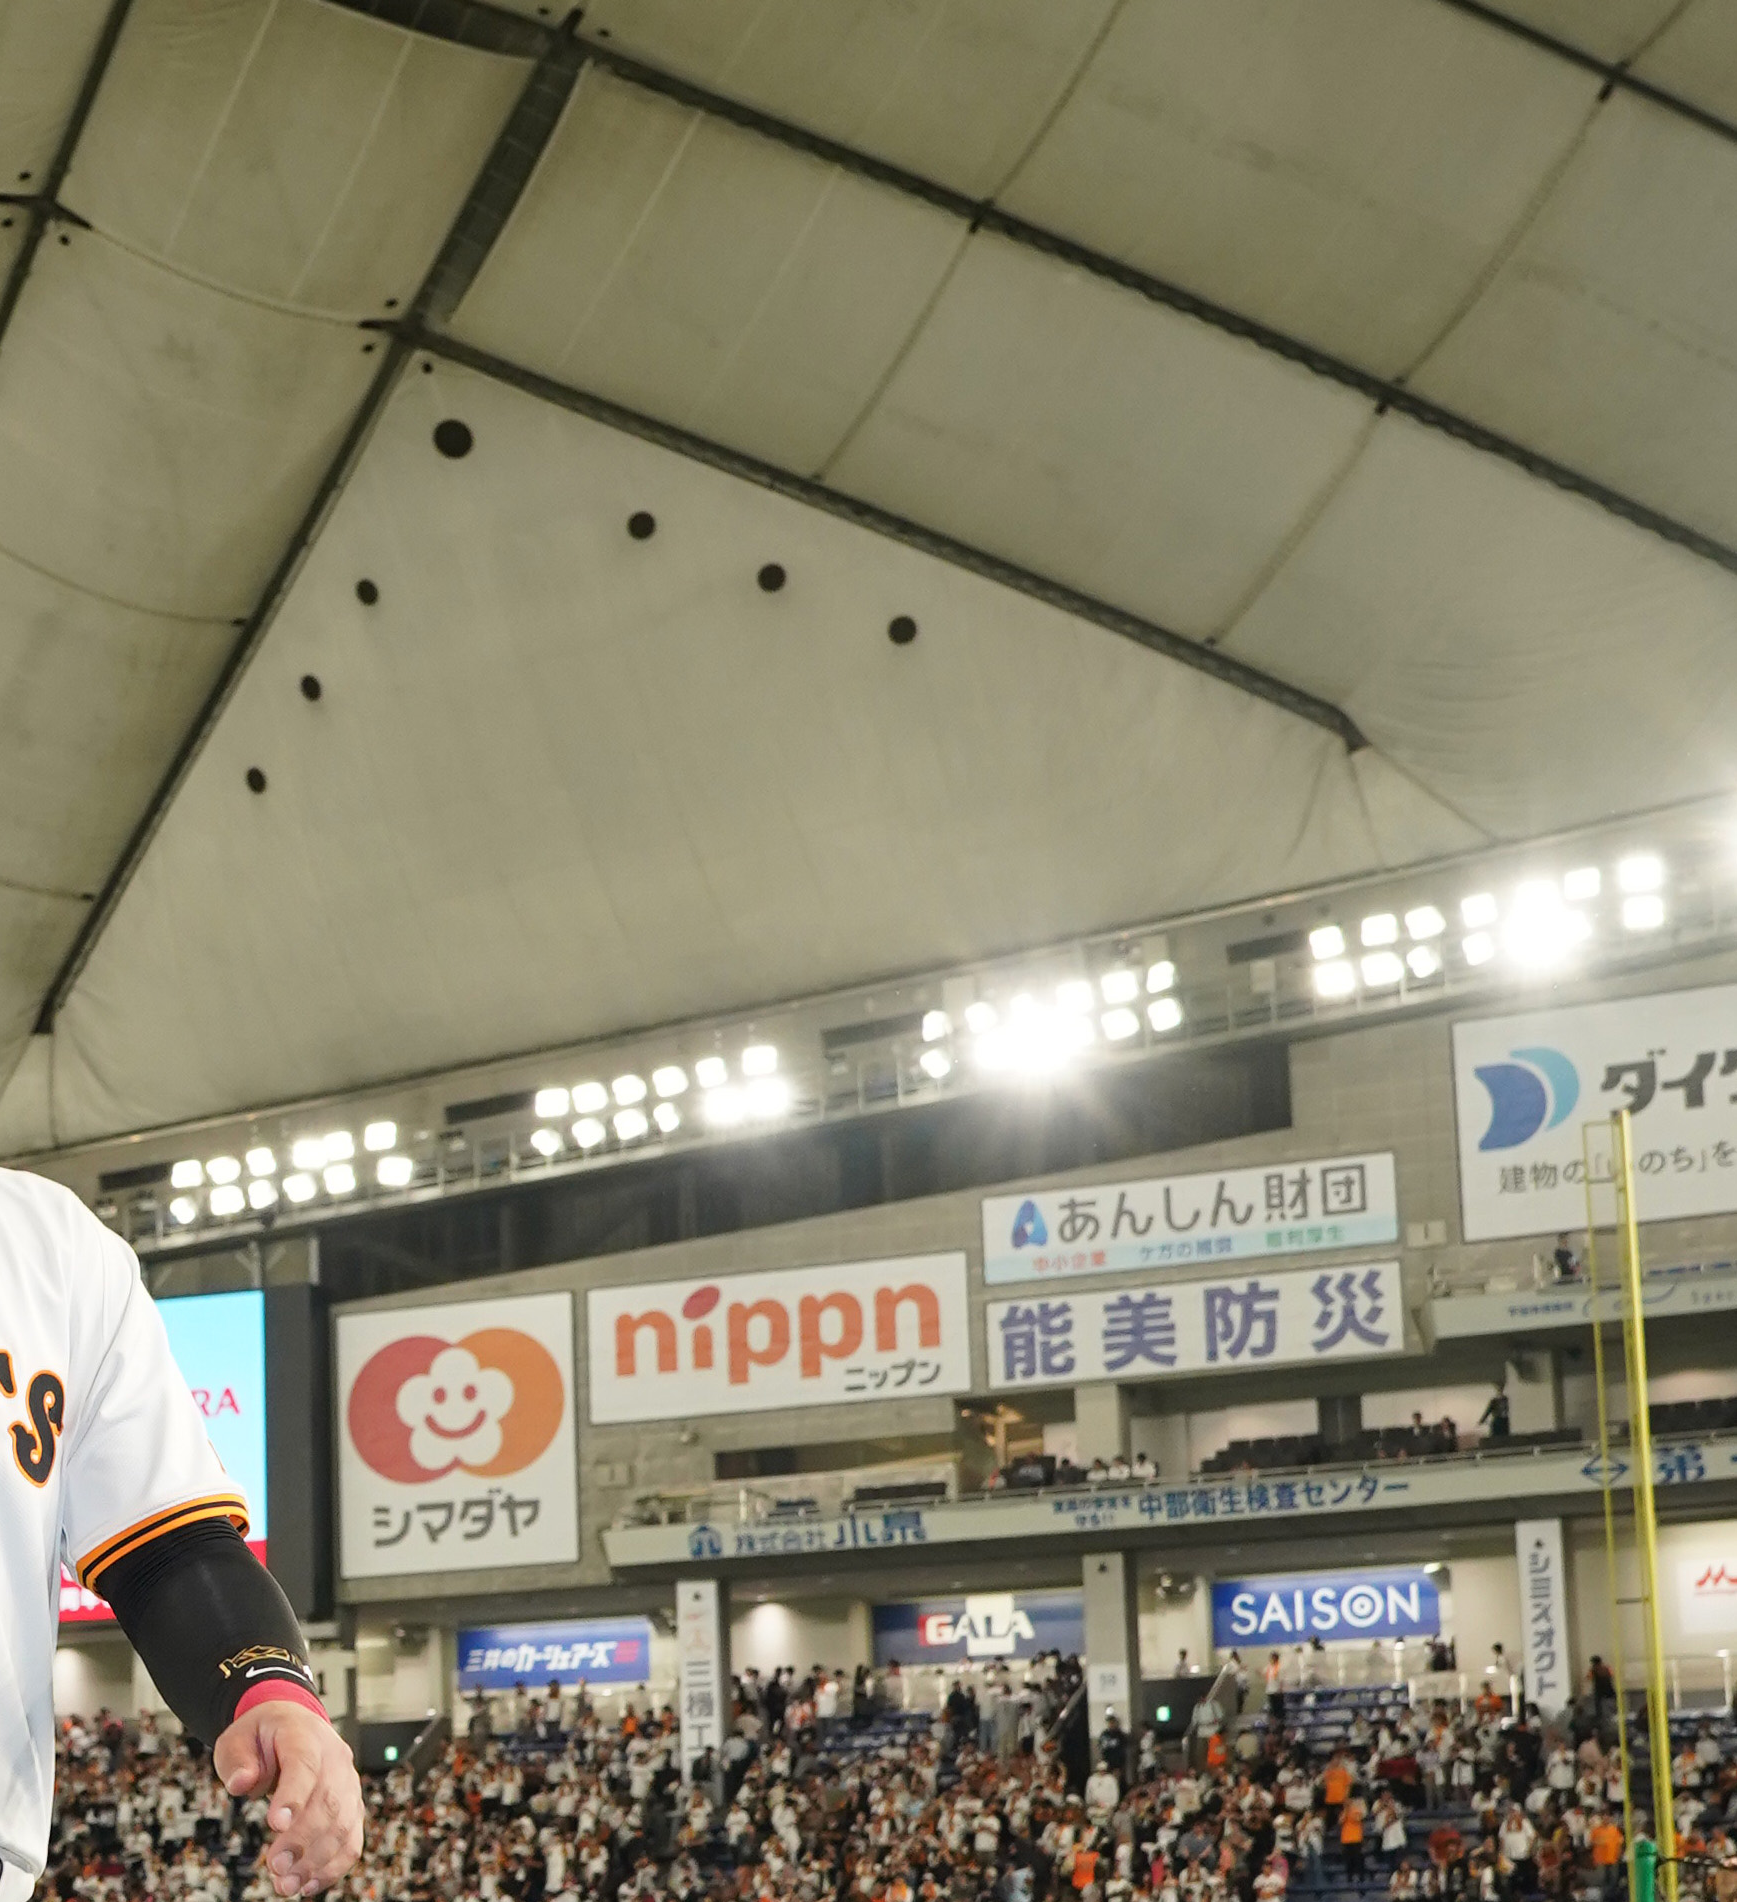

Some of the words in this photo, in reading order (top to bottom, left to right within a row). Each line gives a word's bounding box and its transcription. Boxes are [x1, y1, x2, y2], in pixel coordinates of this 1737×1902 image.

[1058, 1163, 1368, 1242] あんしん財団
[615, 1284, 942, 1386] nippn
[1000, 1269, 1391, 1381] 能美防災
[844, 1358, 942, 1392] ニップン
[1656, 1444, 1737, 1485] 第
[373, 1488, 541, 1547] シマダヤ
[1138, 1474, 1409, 1522] 中部衛生検査センター
[1231, 1582, 1421, 1637] SAISON
